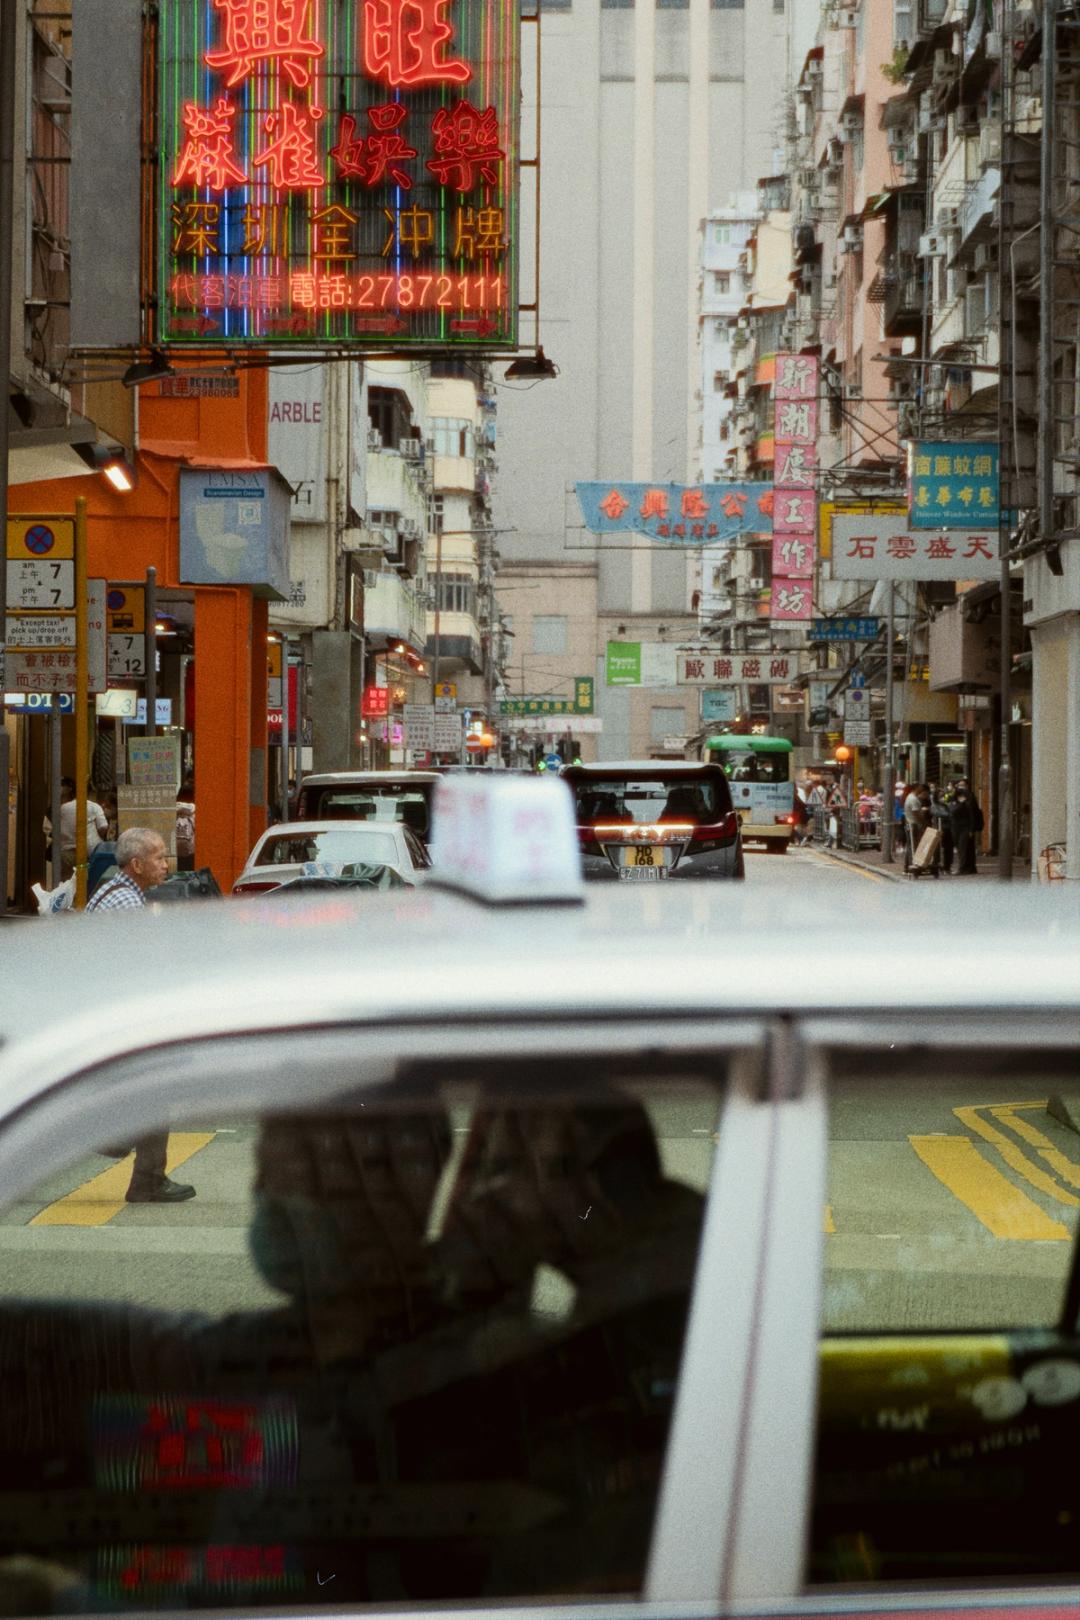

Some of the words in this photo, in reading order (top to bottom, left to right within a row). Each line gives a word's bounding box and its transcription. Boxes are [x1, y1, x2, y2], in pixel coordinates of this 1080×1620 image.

[172, 99, 505, 190] 麻雀娛樂
[19, 571, 40, 580] 上午
[50, 563, 61, 579] 7
[19, 596, 39, 605] 下午
[50, 589, 62, 604] 7
[124, 636, 134, 650] 7
[125, 659, 142, 672] 12
[636, 846, 653, 856] HD
[634, 856, 655, 866] 168
